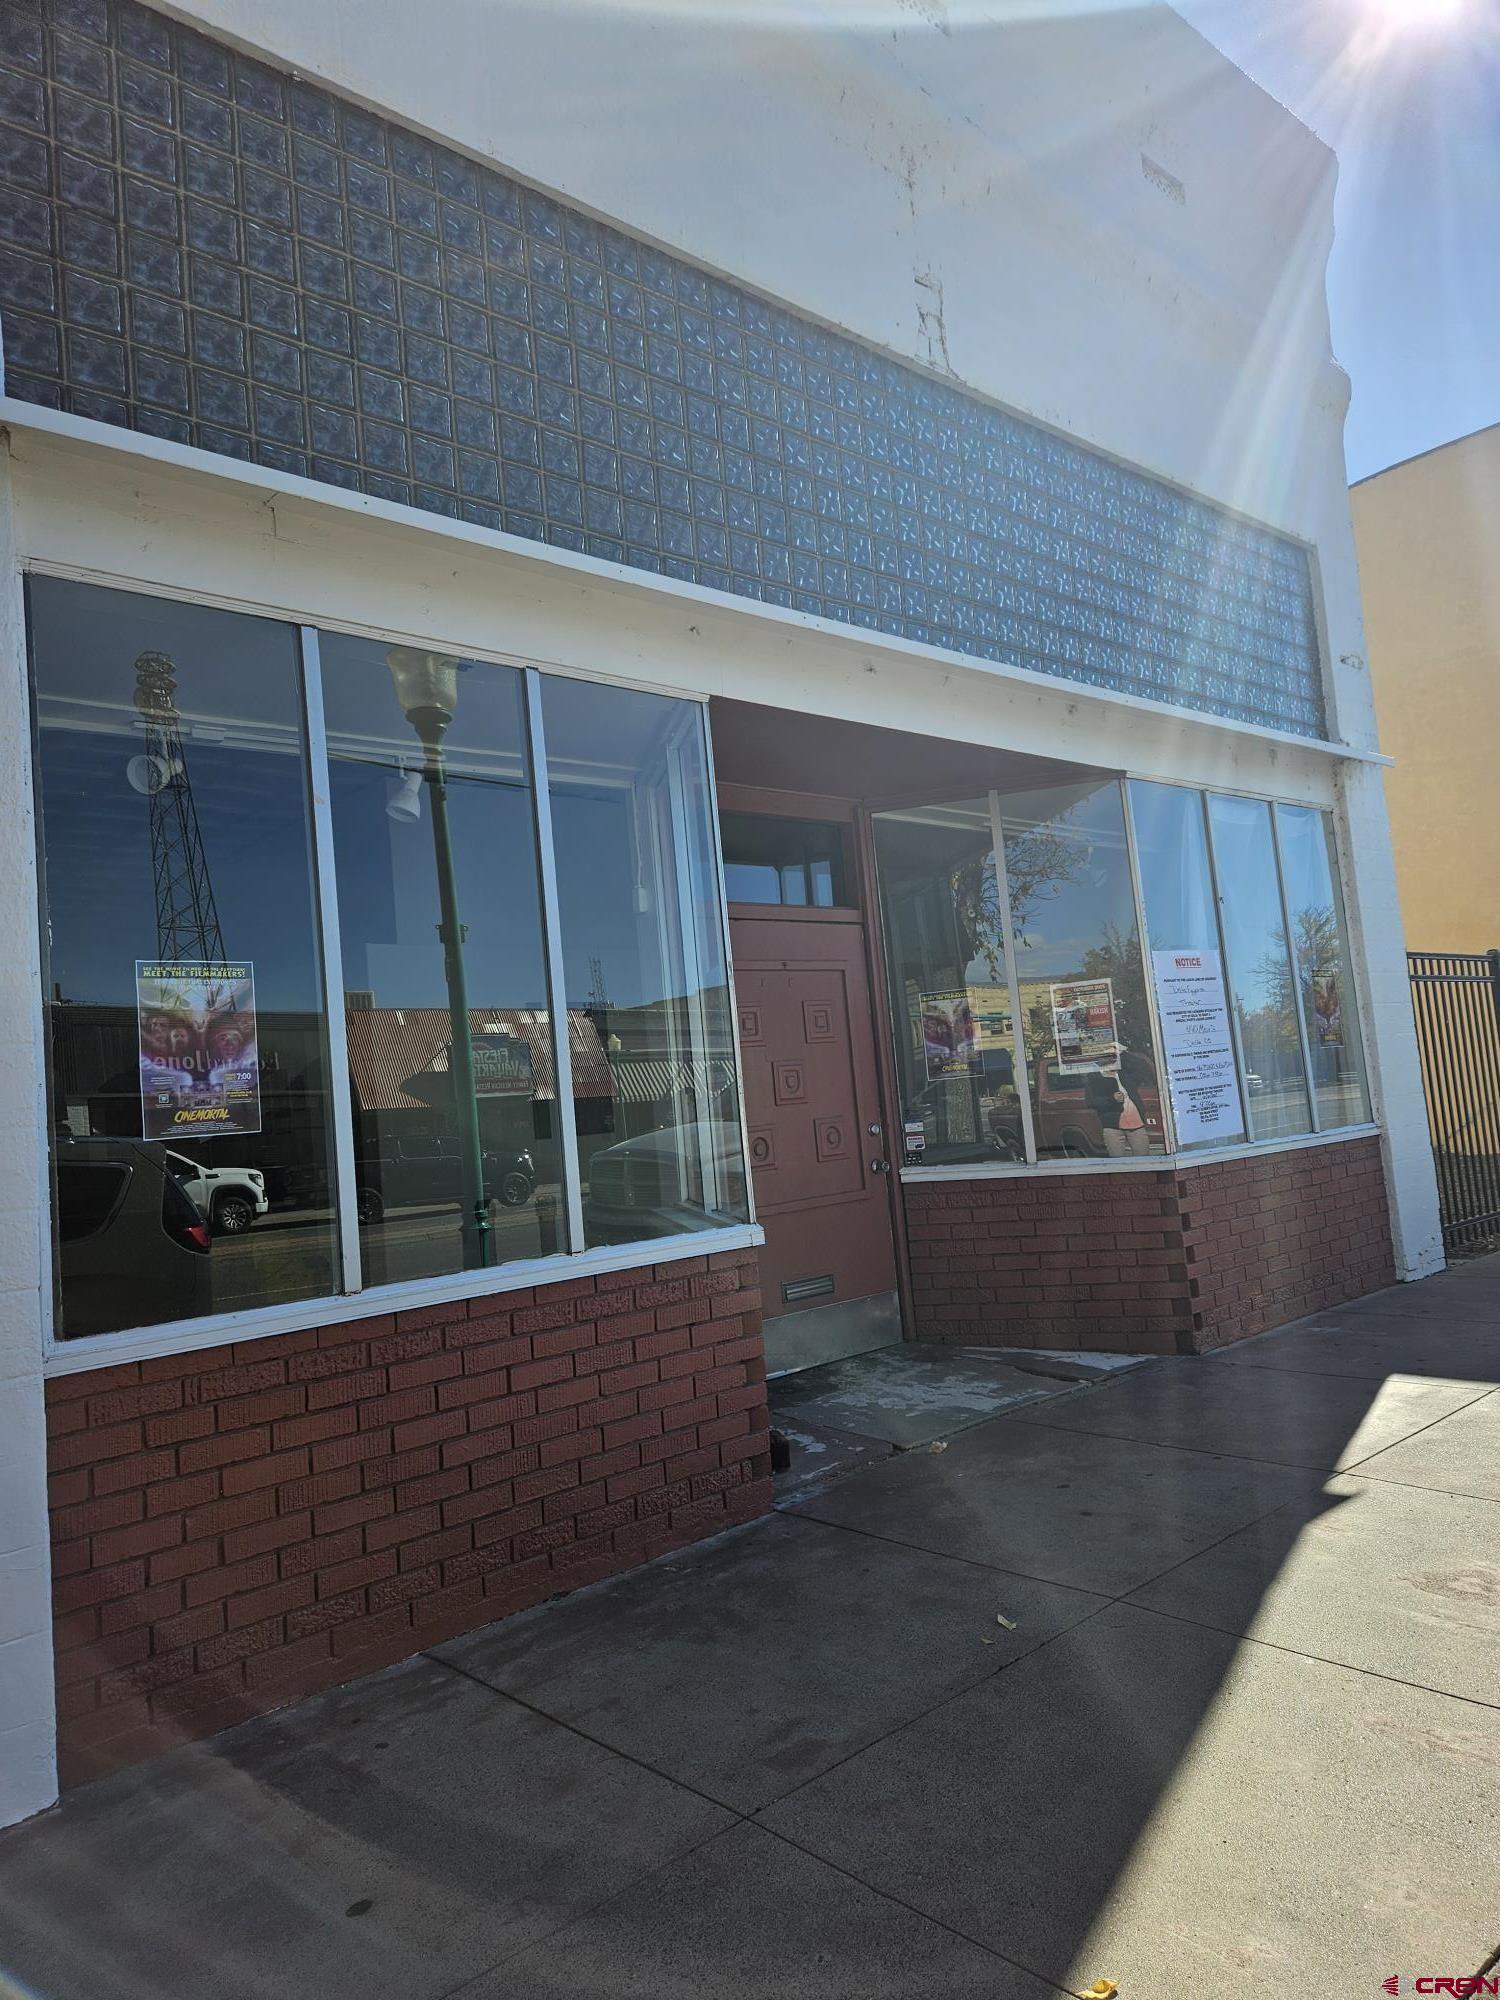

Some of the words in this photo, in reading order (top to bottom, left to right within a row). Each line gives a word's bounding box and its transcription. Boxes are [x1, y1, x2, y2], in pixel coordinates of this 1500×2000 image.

[1175, 957, 1202, 967] NOTICE
[190, 970, 246, 978] FILMMAKERS!
[236, 1072, 252, 1080] 7:00
[174, 1107, 231, 1123] CINEMORTAL
